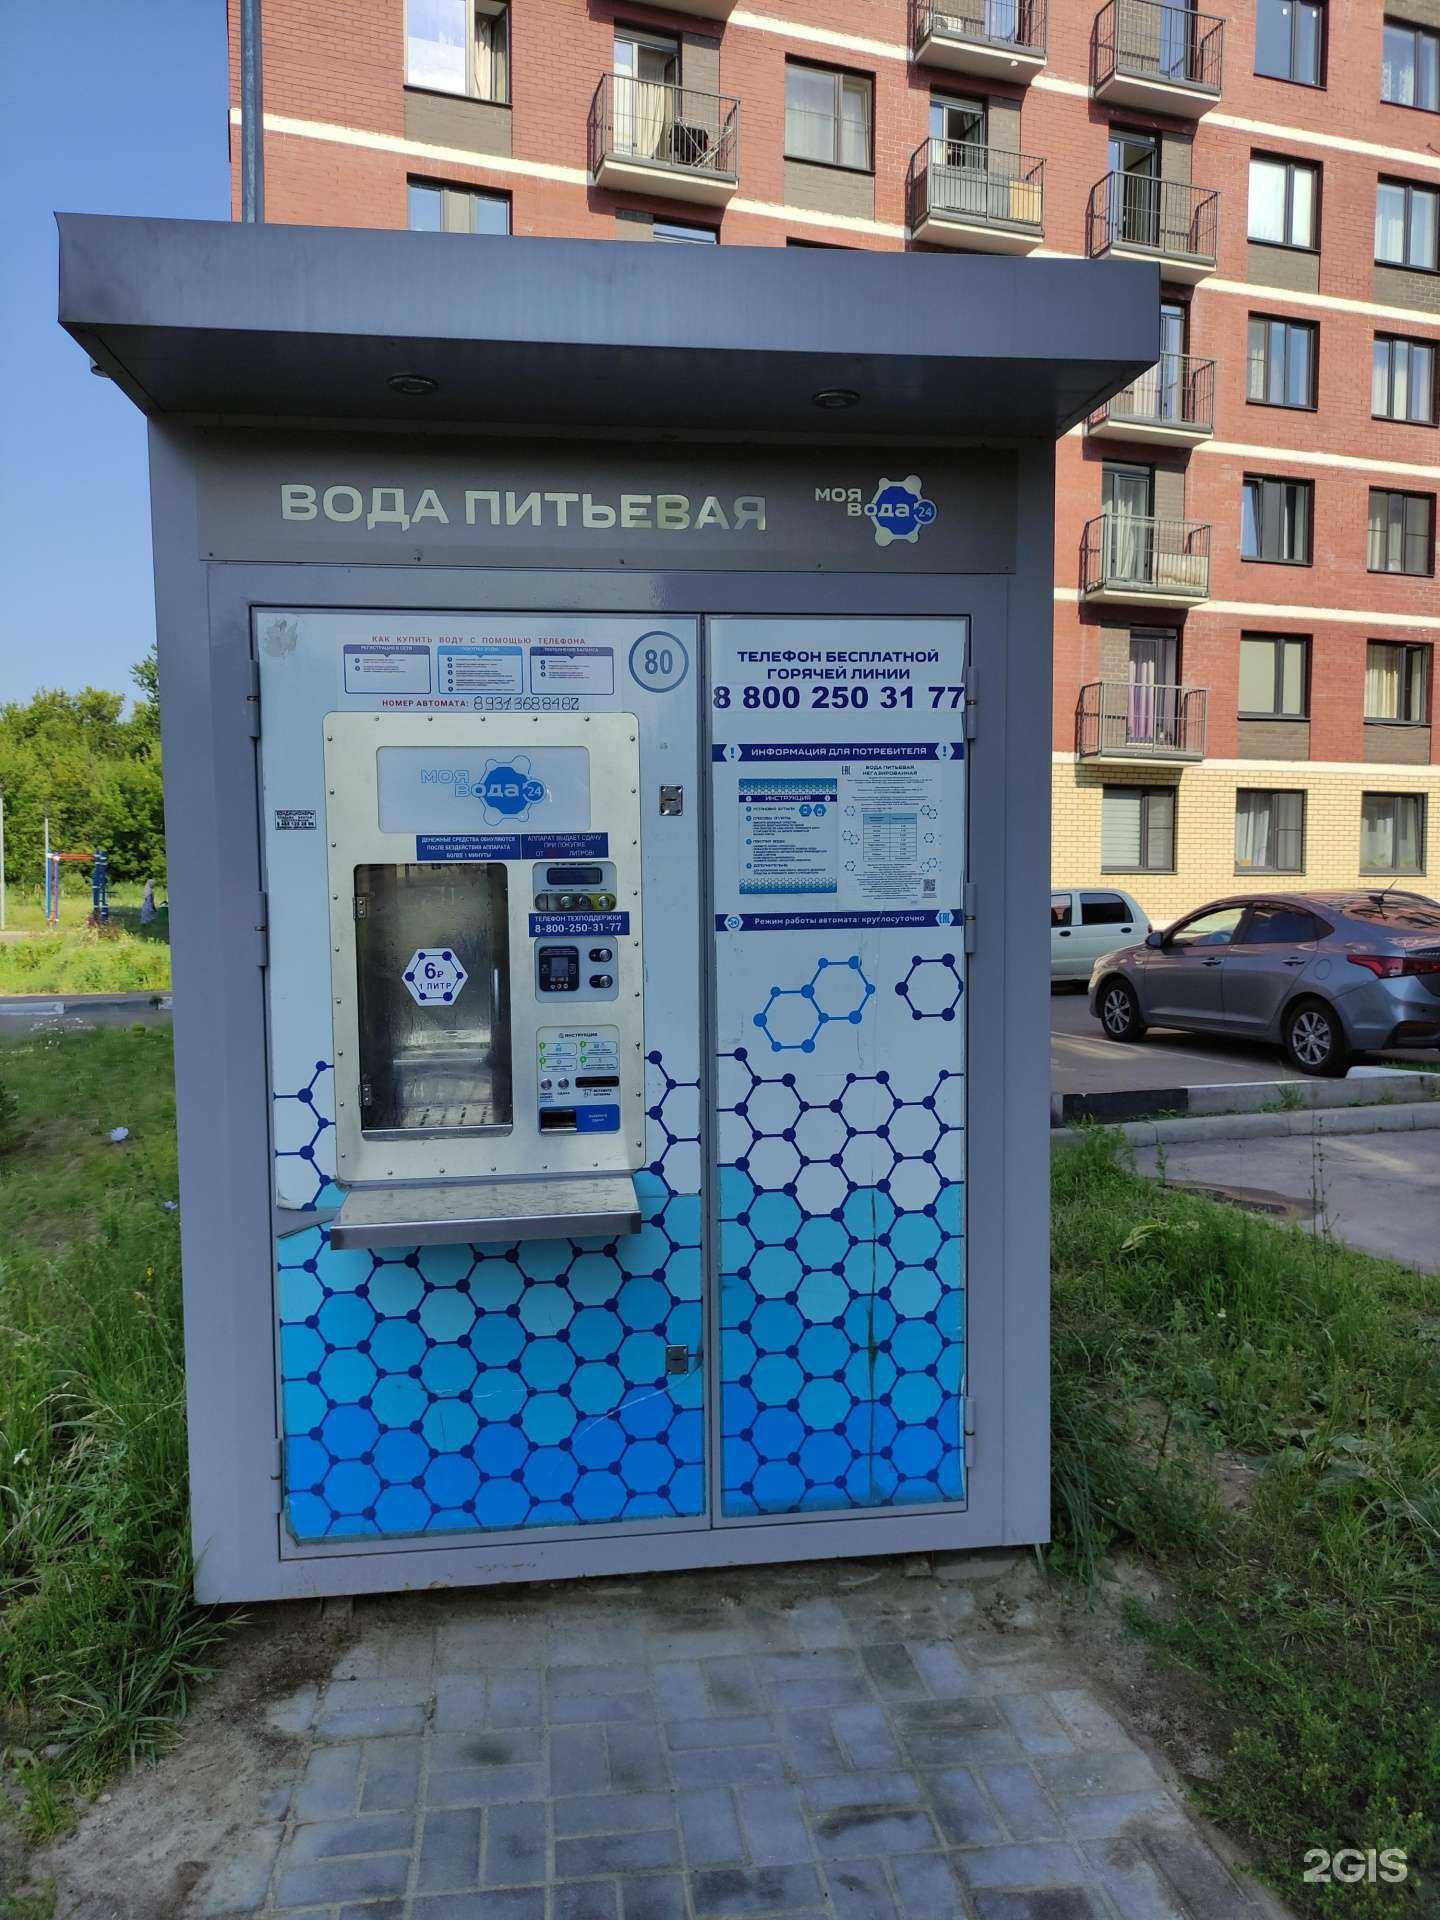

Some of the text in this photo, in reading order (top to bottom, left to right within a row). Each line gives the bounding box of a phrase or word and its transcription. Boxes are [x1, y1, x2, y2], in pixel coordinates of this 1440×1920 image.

[815, 487, 862, 502] МОЯ
[281, 485, 767, 531] ВОДА ПИТЬЕВАЯ
[918, 507, 932, 518] 24
[372, 635, 390, 643] КАК
[439, 637, 464, 645] ВОДУ
[482, 638, 532, 646] ПОМОЩЬЮ
[645, 649, 673, 675] 80
[737, 649, 939, 663] ТЕЛЕФОН БЕСПЛАТНОЙ
[767, 666, 911, 680] ГОРЯЧЕЙ ЛИНИИ
[713, 686, 965, 709] 8 800 250 31 77
[751, 747, 927, 757] ИНФОРМАЦИЯ ДЛЯ ПОТРЕБИТЕЛЯ
[421, 769, 470, 784] МОЯ
[528, 786, 542, 797] 24
[567, 914, 622, 922] ТЕХПОДДЕРЖКИ
[785, 917, 817, 927] работы
[861, 915, 925, 925] круглосуточно
[535, 923, 622, 933] 8-800-250-31-77
